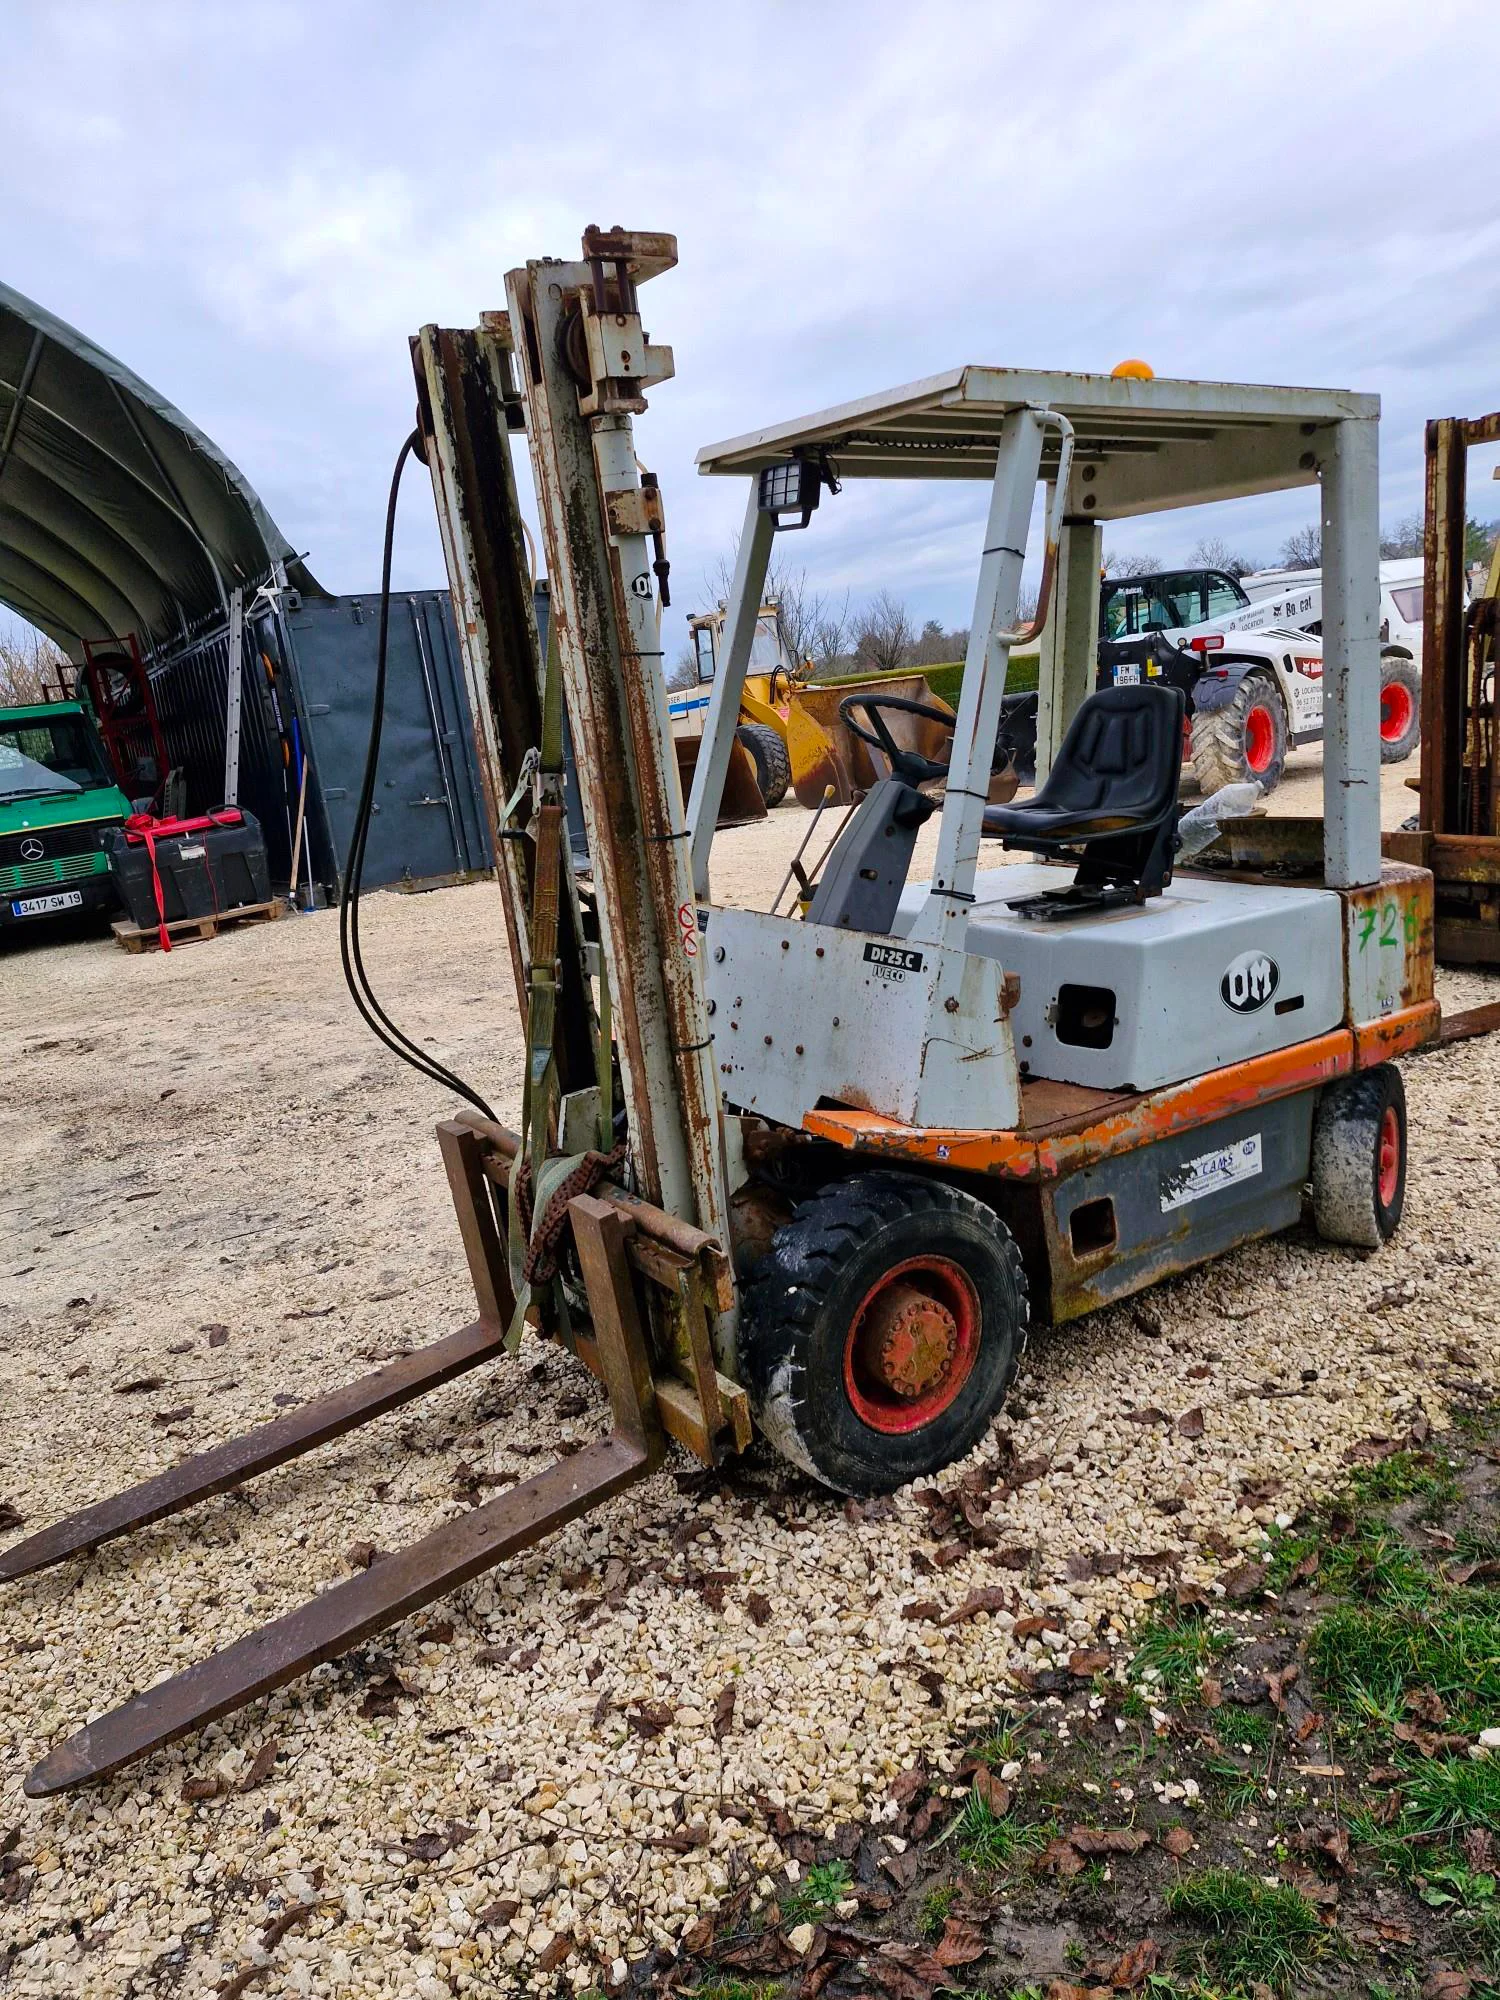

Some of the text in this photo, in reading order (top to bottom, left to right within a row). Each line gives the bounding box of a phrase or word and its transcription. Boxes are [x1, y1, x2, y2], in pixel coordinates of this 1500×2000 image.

[1241, 617, 1264, 631] LOCATION
[1120, 666, 1130, 674] FM
[21, 893, 81, 912] 3417 SW 19
[1358, 896, 1420, 953] 726
[870, 947, 915, 967] DI-25.C
[872, 965, 906, 983] IVECO
[1229, 959, 1272, 1006] OM
